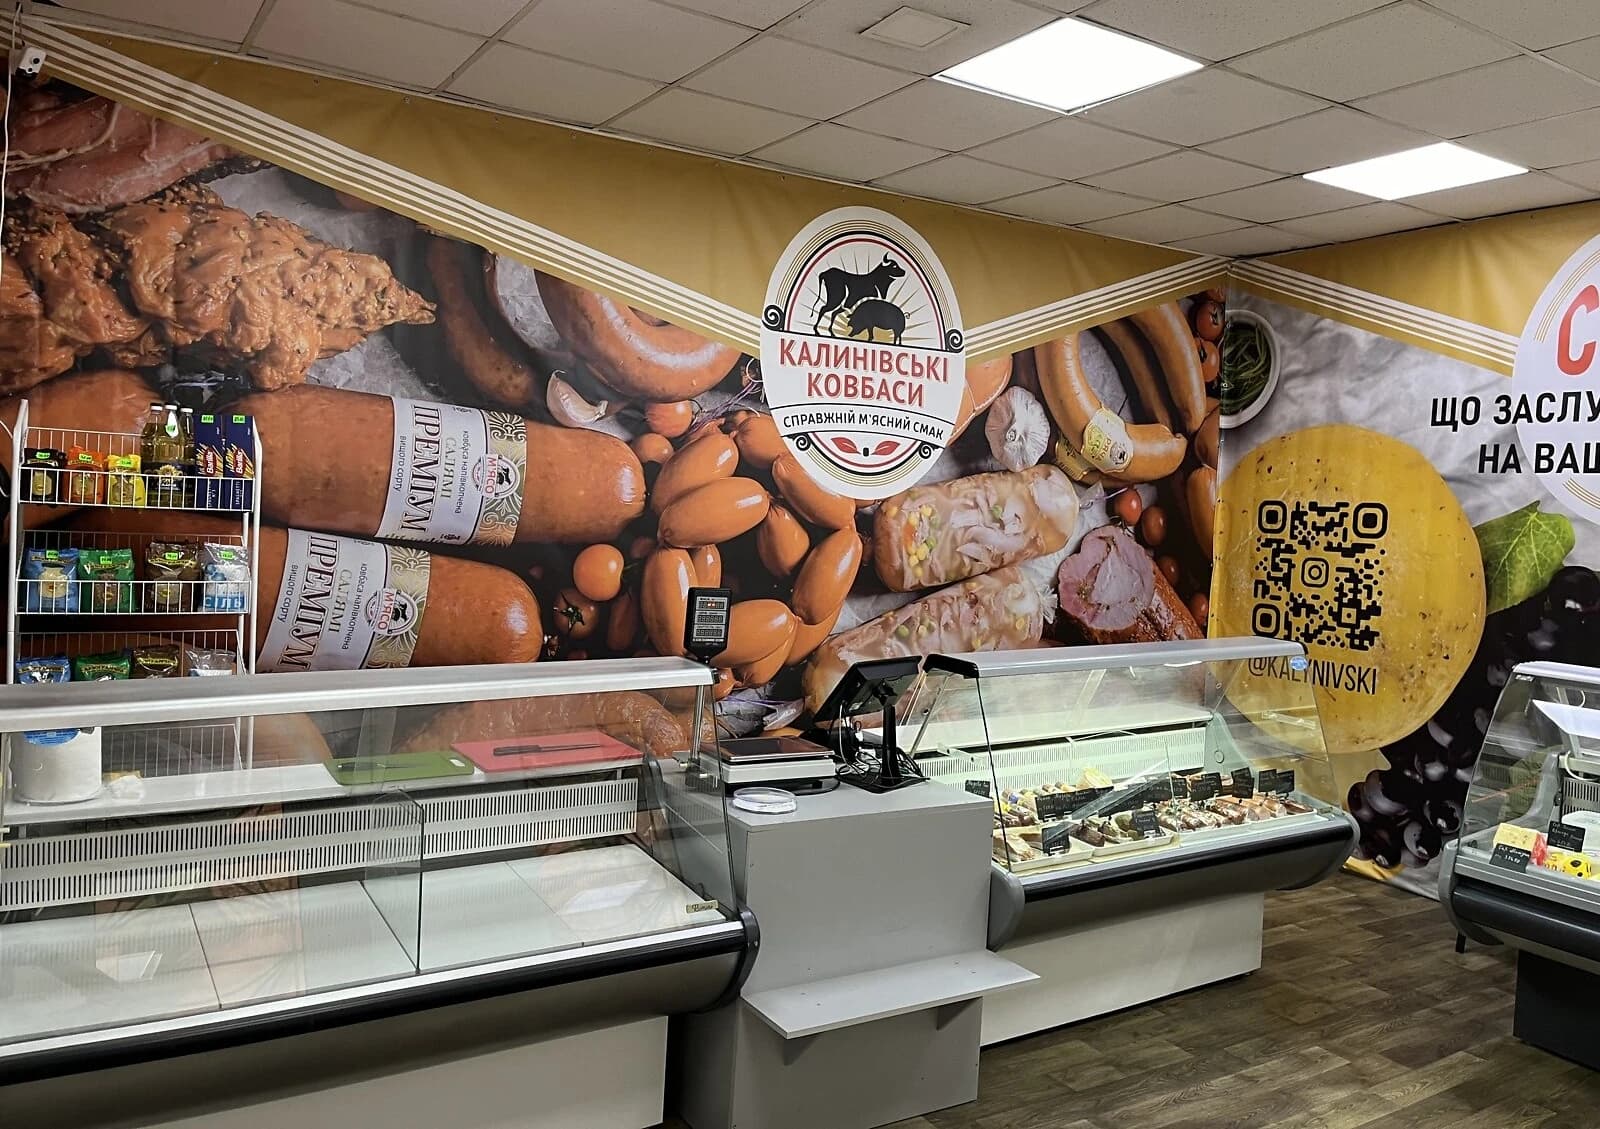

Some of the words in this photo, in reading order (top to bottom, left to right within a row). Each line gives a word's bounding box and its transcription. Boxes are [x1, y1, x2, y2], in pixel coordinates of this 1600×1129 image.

[780, 338, 949, 383] КАЛИНІВСЬКІ
[807, 372, 925, 407] КОВБАСИ
[783, 409, 856, 428] СПРАВЖНІЙ
[913, 421, 944, 441] СМАК
[1431, 396, 1481, 432] ЩО
[461, 431, 470, 460] ковбаса
[1478, 443, 1522, 474] НА
[394, 467, 404, 492] сорту
[401, 405, 440, 532] ПРЕМІУМ
[439, 437, 456, 498] САЛЯМІ
[455, 462, 469, 514] напівкопчена
[357, 563, 368, 592] ковбаса
[278, 596, 291, 622] сорту
[280, 536, 338, 668] ПРЕМІУМ
[329, 569, 352, 632] САЛЯМІ
[342, 595, 361, 650] напівкопчена
